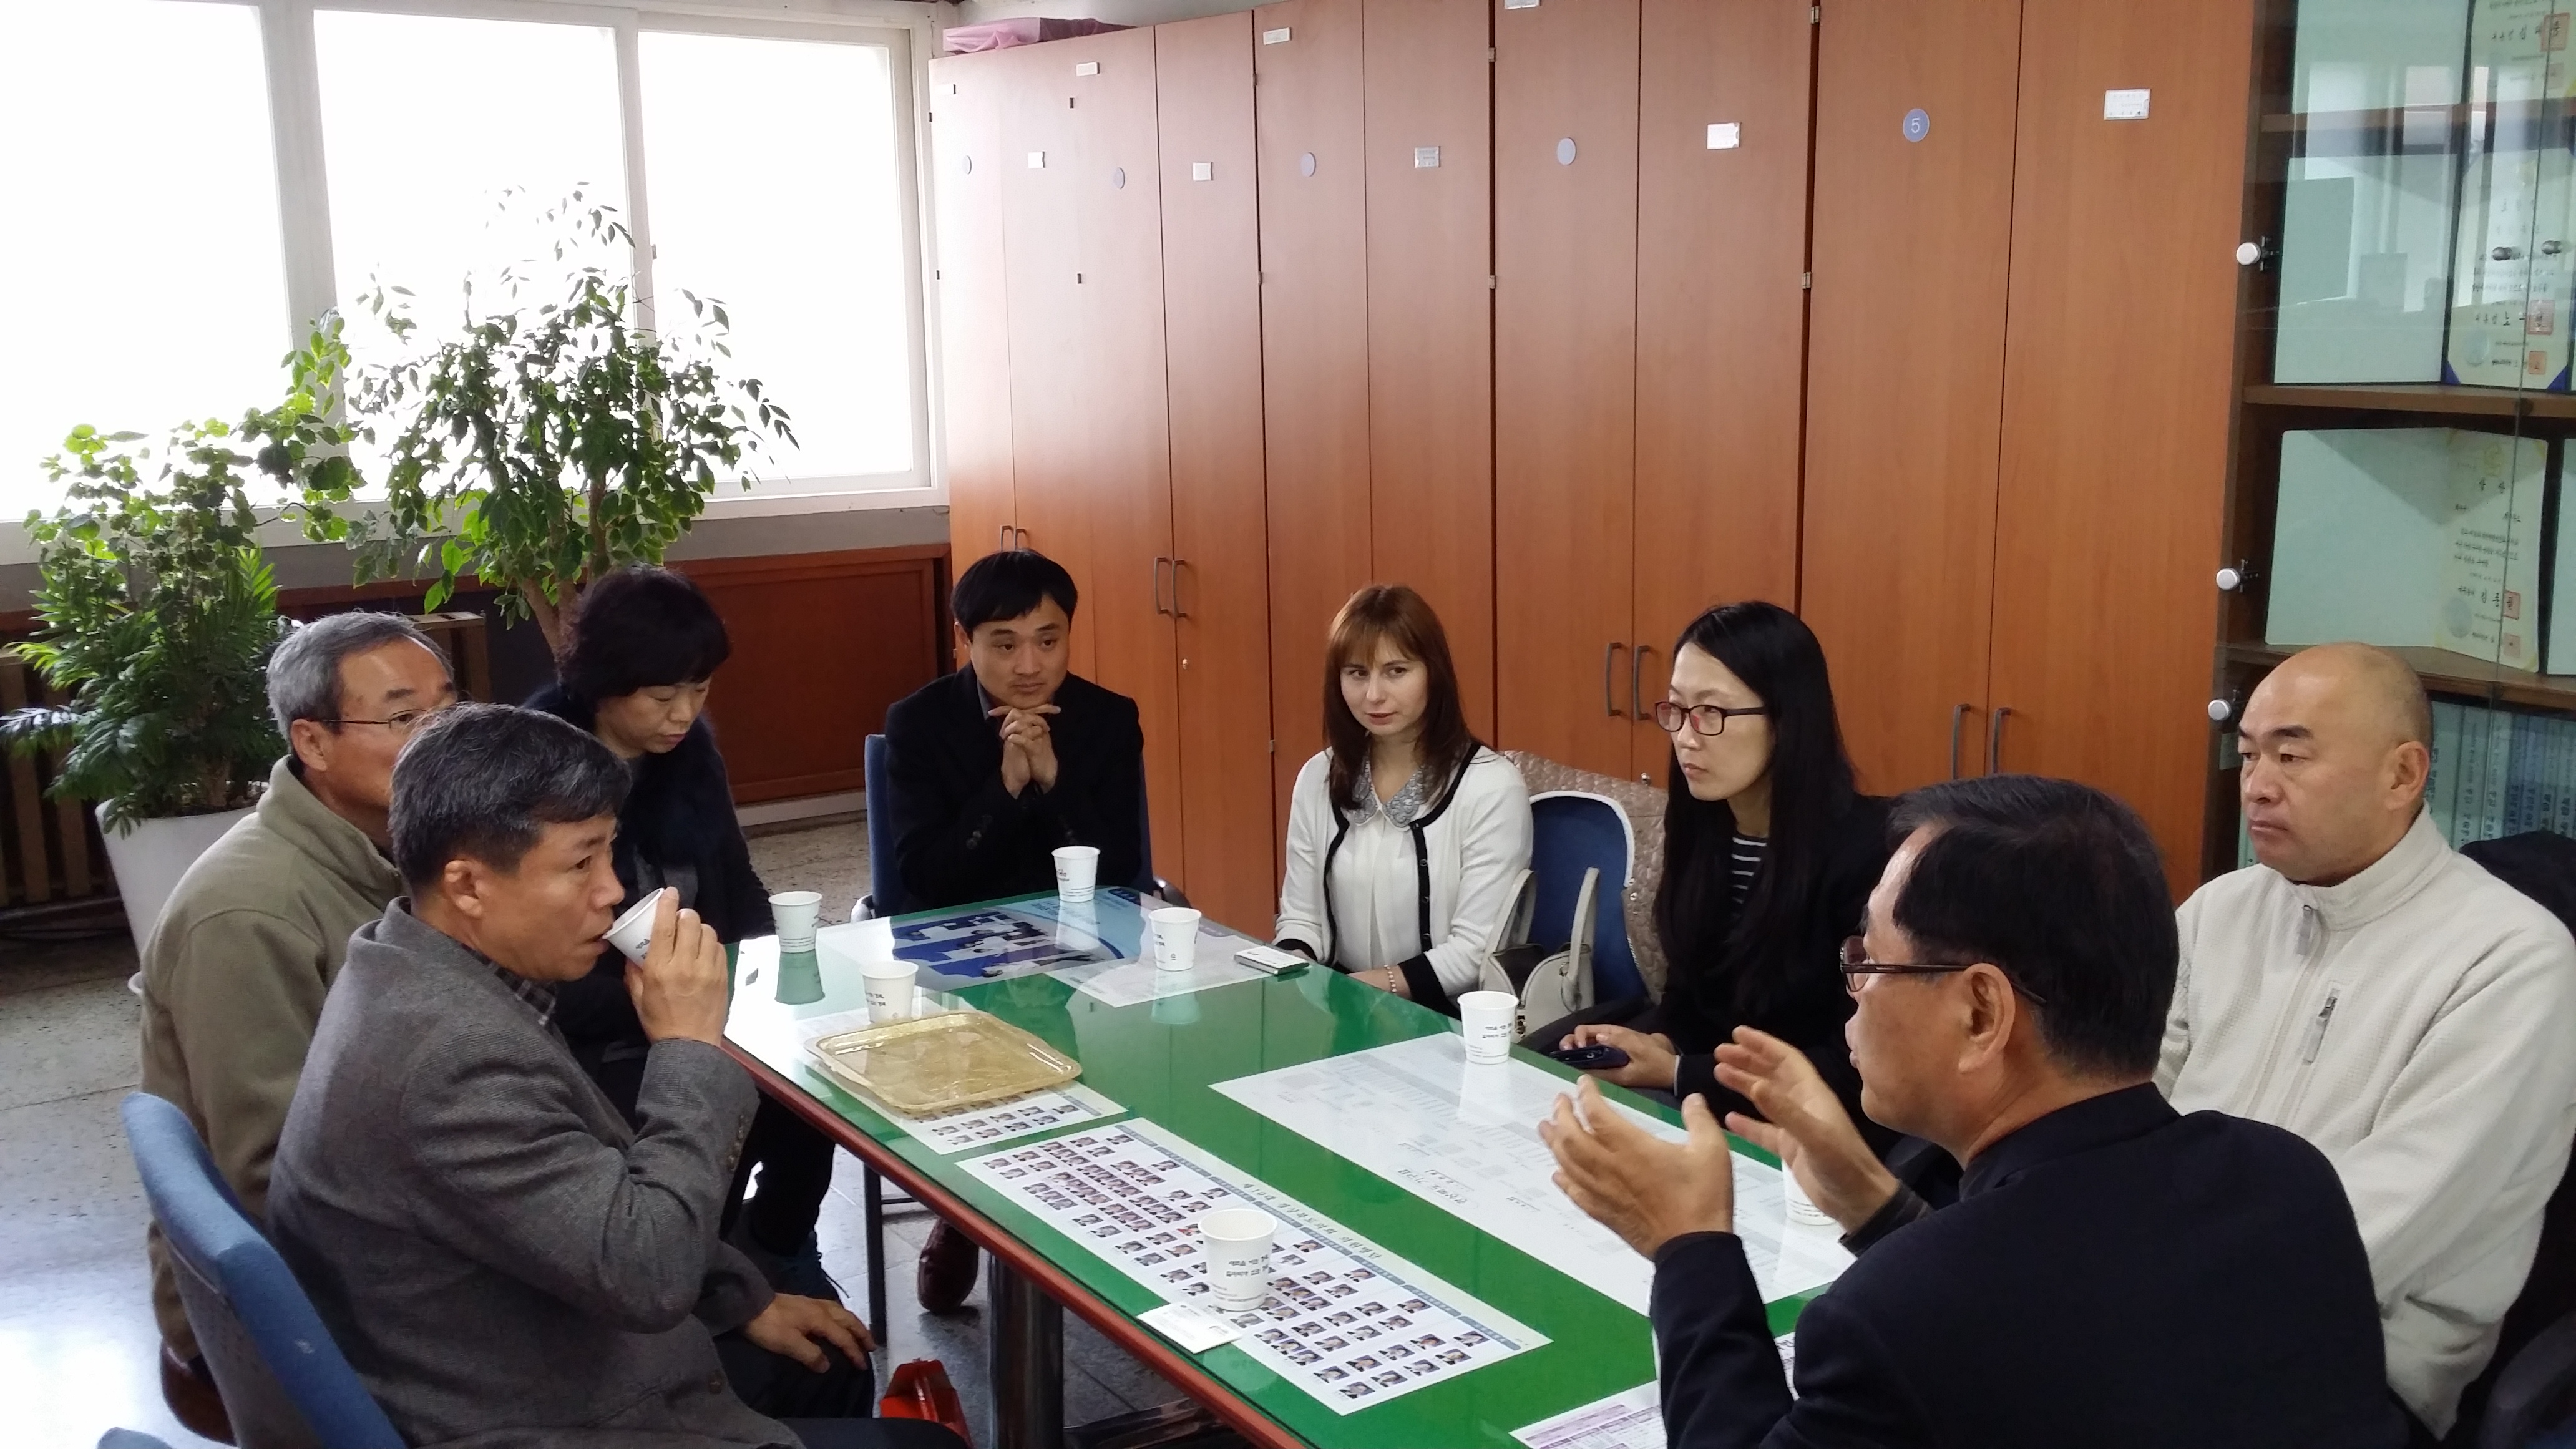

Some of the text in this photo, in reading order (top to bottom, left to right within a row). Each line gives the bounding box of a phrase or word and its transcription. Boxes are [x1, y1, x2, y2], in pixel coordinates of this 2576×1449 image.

[1911, 117, 1920, 134] 5
[1244, 1183, 1276, 1201] 제10대
[1279, 1202, 1338, 1234] 경상북도의회
[1340, 1236, 1383, 1259] 의원명단
